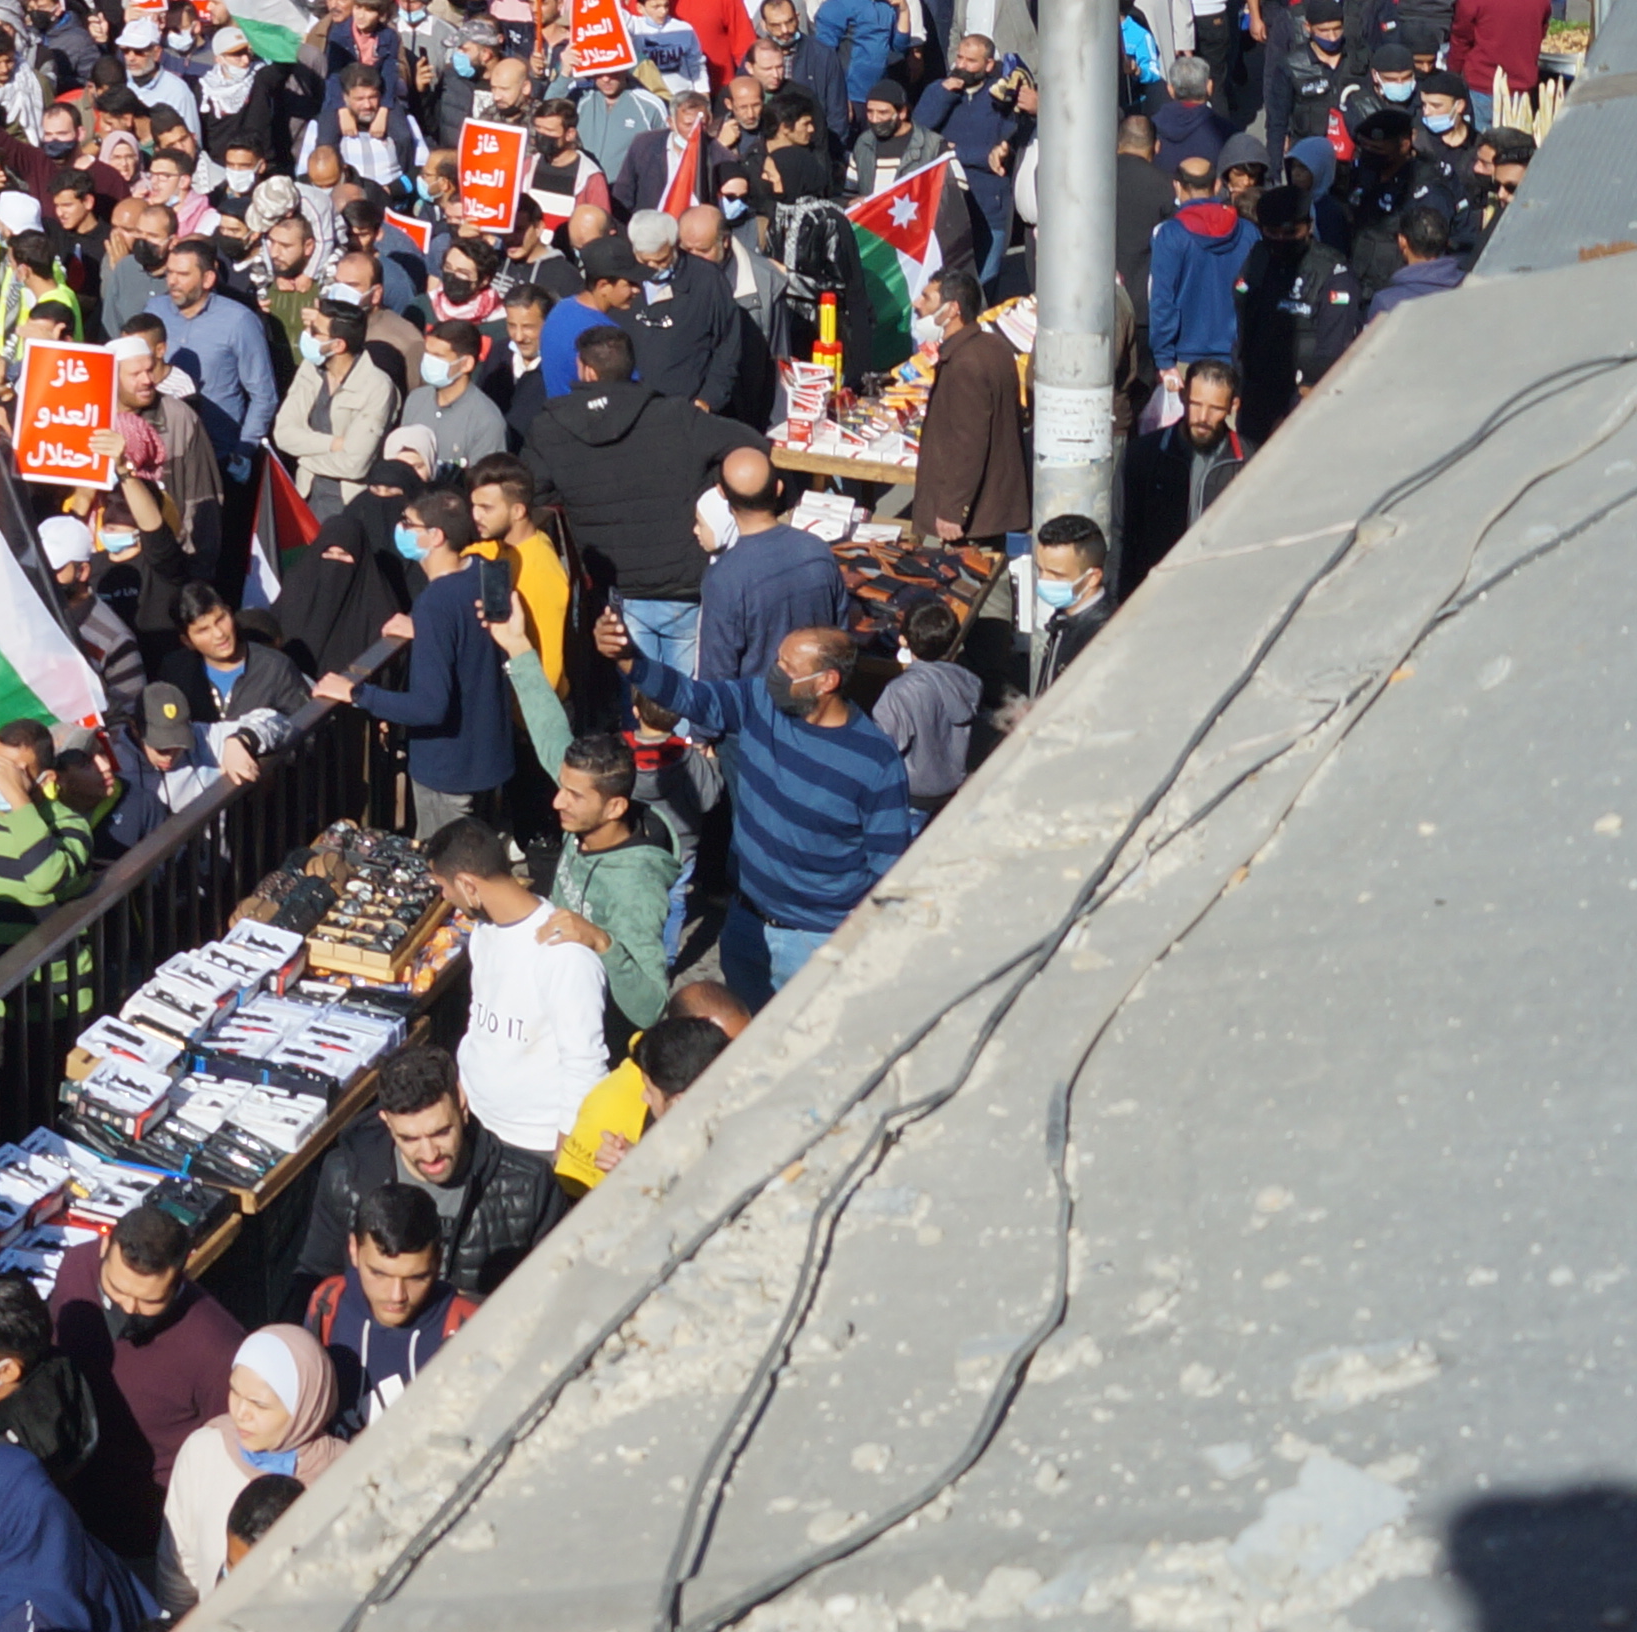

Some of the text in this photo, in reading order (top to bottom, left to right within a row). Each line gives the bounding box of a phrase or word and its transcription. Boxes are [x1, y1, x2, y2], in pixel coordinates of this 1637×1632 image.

[576, 17, 613, 41] العدو
[579, 43, 625, 68] احتلال
[472, 132, 500, 155] غاز
[464, 168, 505, 188] العدو
[48, 358, 91, 386] غاز
[33, 395, 100, 428] العدو
[25, 438, 101, 473] احتلال
